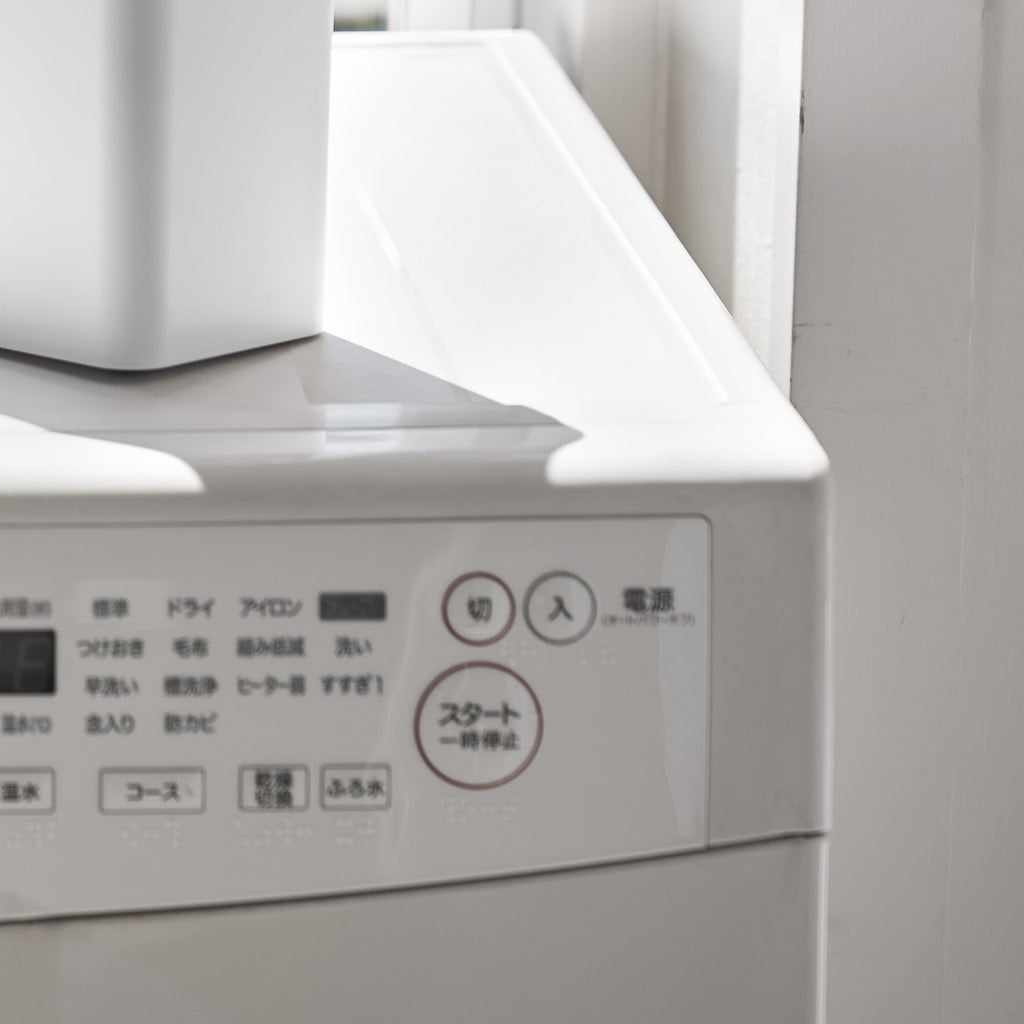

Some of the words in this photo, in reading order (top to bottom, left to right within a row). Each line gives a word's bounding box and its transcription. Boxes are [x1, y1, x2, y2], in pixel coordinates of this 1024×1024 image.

[168, 597, 215, 618] ドライ
[240, 597, 303, 618] アイロン
[466, 597, 492, 622] 切
[548, 595, 573, 622] 入
[622, 587, 674, 613] 電源
[77, 638, 144, 658] つけおき
[173, 637, 208, 658] 毛布
[335, 636, 372, 657] 洗い
[85, 676, 139, 697] 早洗い
[438, 702, 520, 728] スタート
[440, 729, 517, 751] 一時停止
[0, 781, 39, 802] 温水
[126, 782, 179, 801] コース
[325, 778, 384, 798] ふろ水
